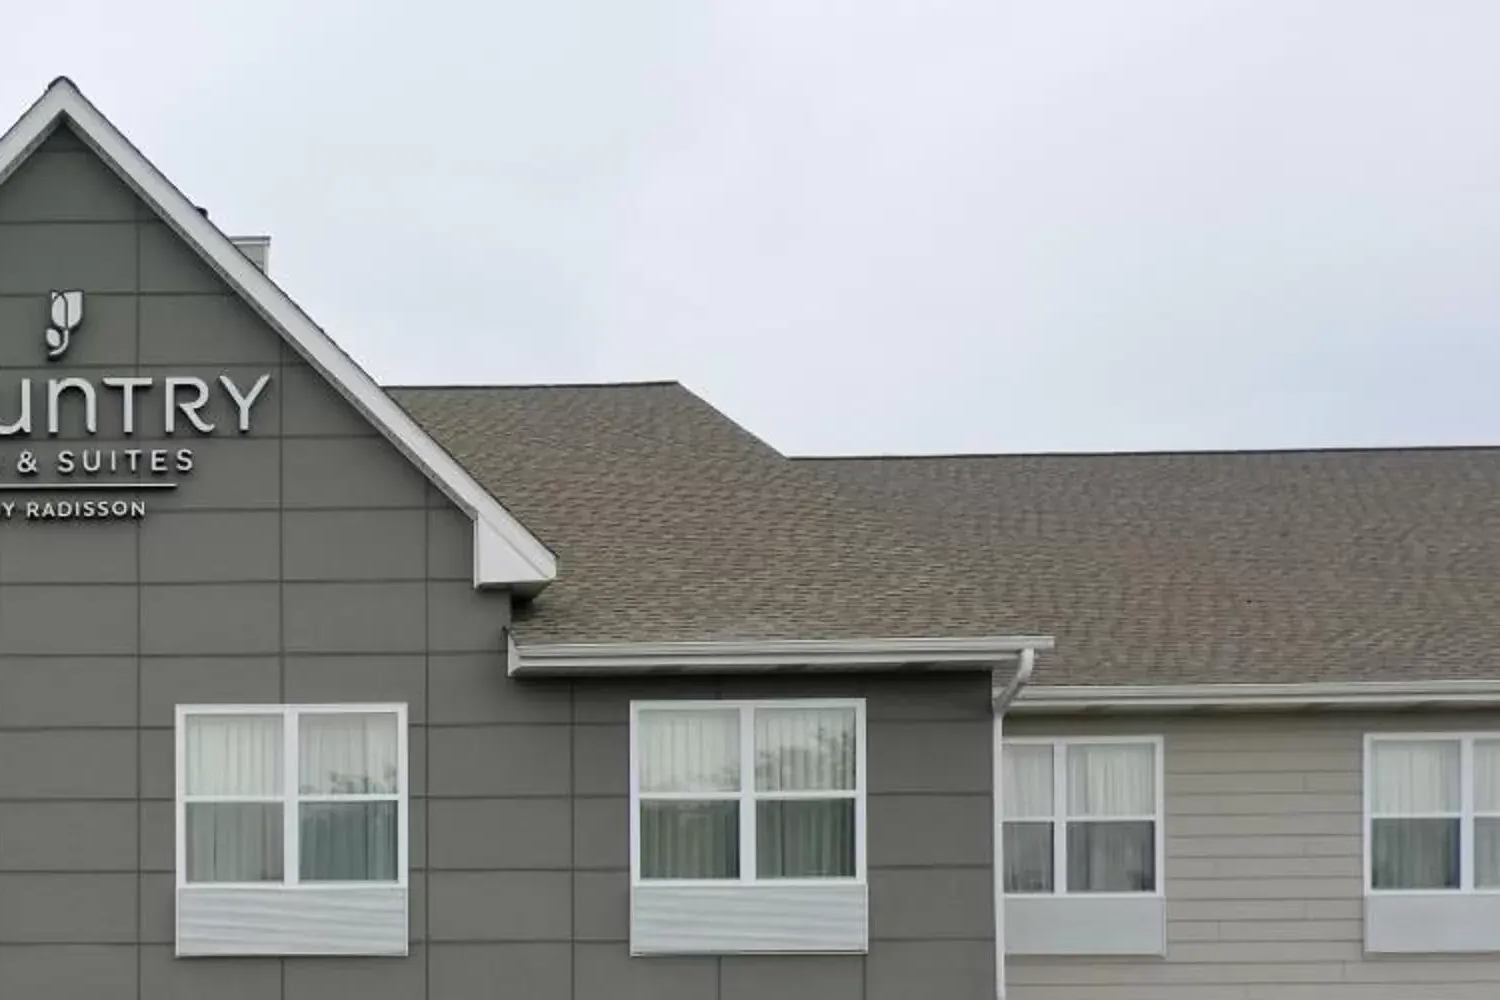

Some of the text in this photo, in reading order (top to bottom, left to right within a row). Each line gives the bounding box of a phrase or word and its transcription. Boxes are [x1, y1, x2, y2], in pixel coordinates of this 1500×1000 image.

[16, 450, 39, 473] &
[56, 448, 195, 473] SUITES
[26, 500, 146, 518] RADISSON
